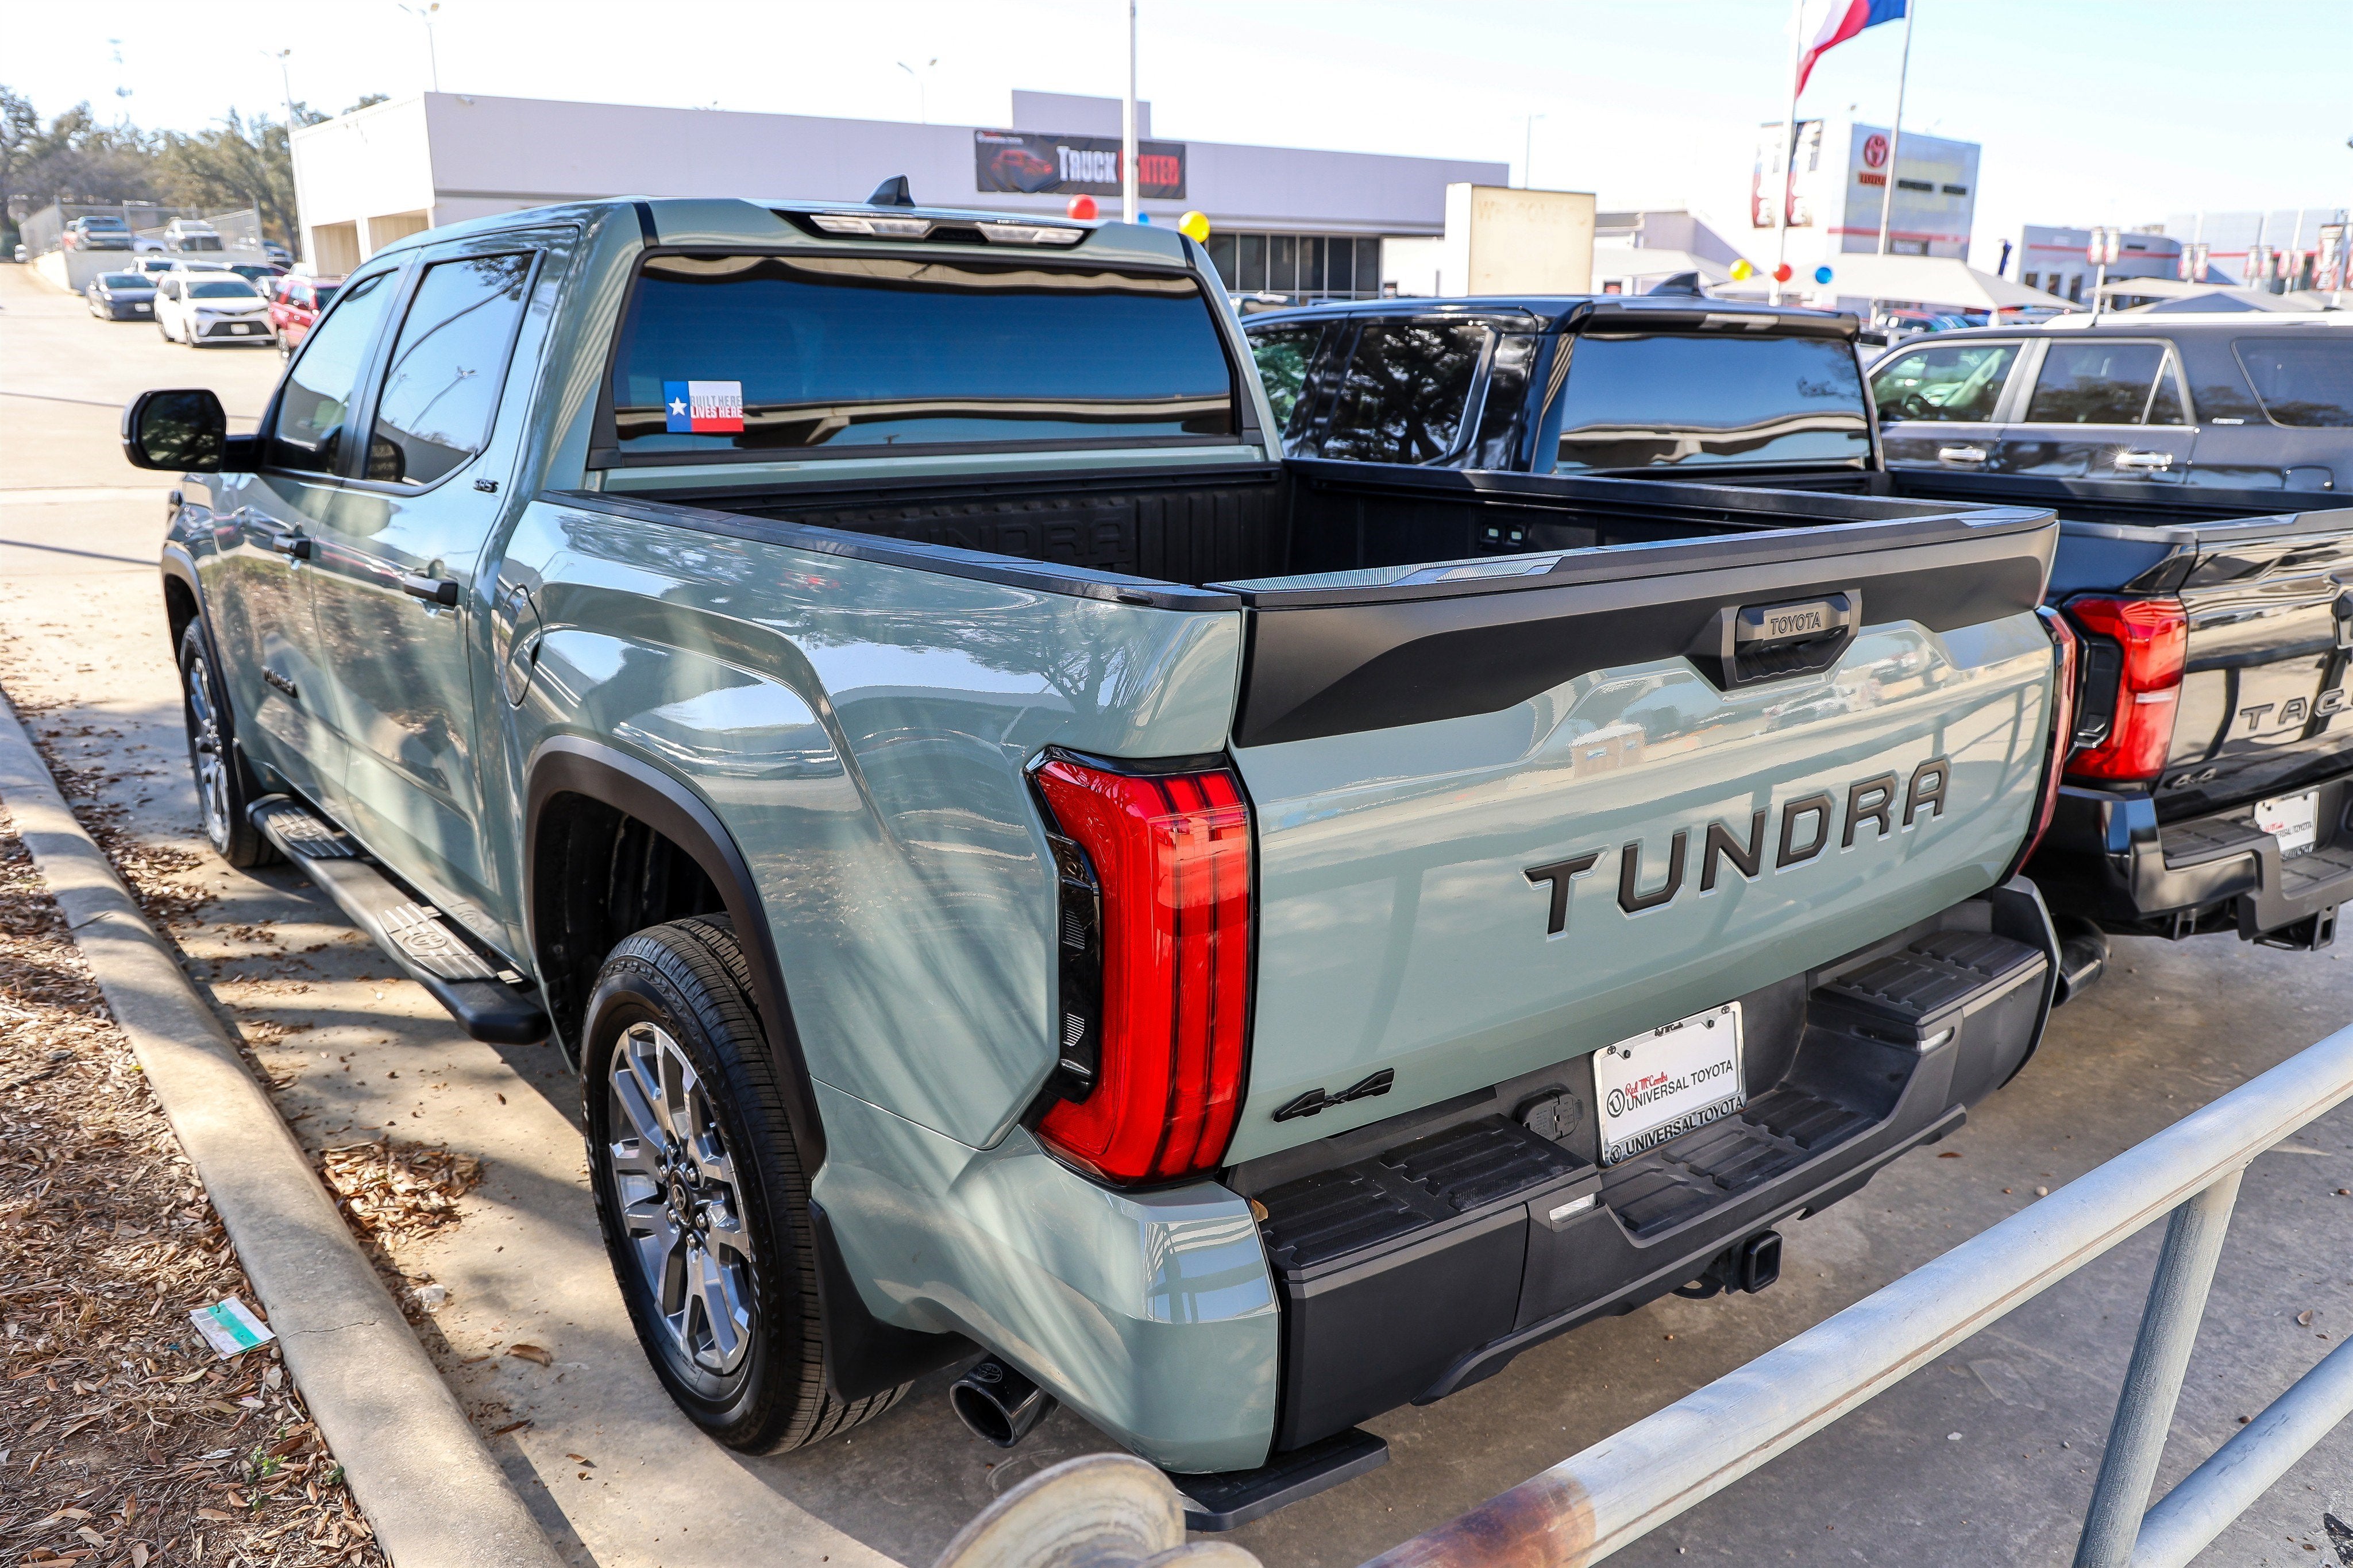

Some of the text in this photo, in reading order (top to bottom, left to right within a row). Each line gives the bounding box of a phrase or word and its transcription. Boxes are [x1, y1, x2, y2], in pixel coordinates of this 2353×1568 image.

[1056, 145, 1180, 186] TRUCK NTER
[691, 395, 741, 406] BUILT HERE
[691, 405, 743, 419] LIVES HERE
[1770, 611, 1821, 635] TOYOTA
[2240, 689, 2353, 731] TAC
[1523, 756, 1951, 939] TUNDRA
[1625, 1081, 1638, 1098] Red
[1627, 1076, 1689, 1111] UNIVERSAL
[1691, 1060, 1733, 1086] TOYOTA
[1626, 1115, 1697, 1155] UNIVERSAL
[1698, 1095, 1744, 1124] TOYOTA
